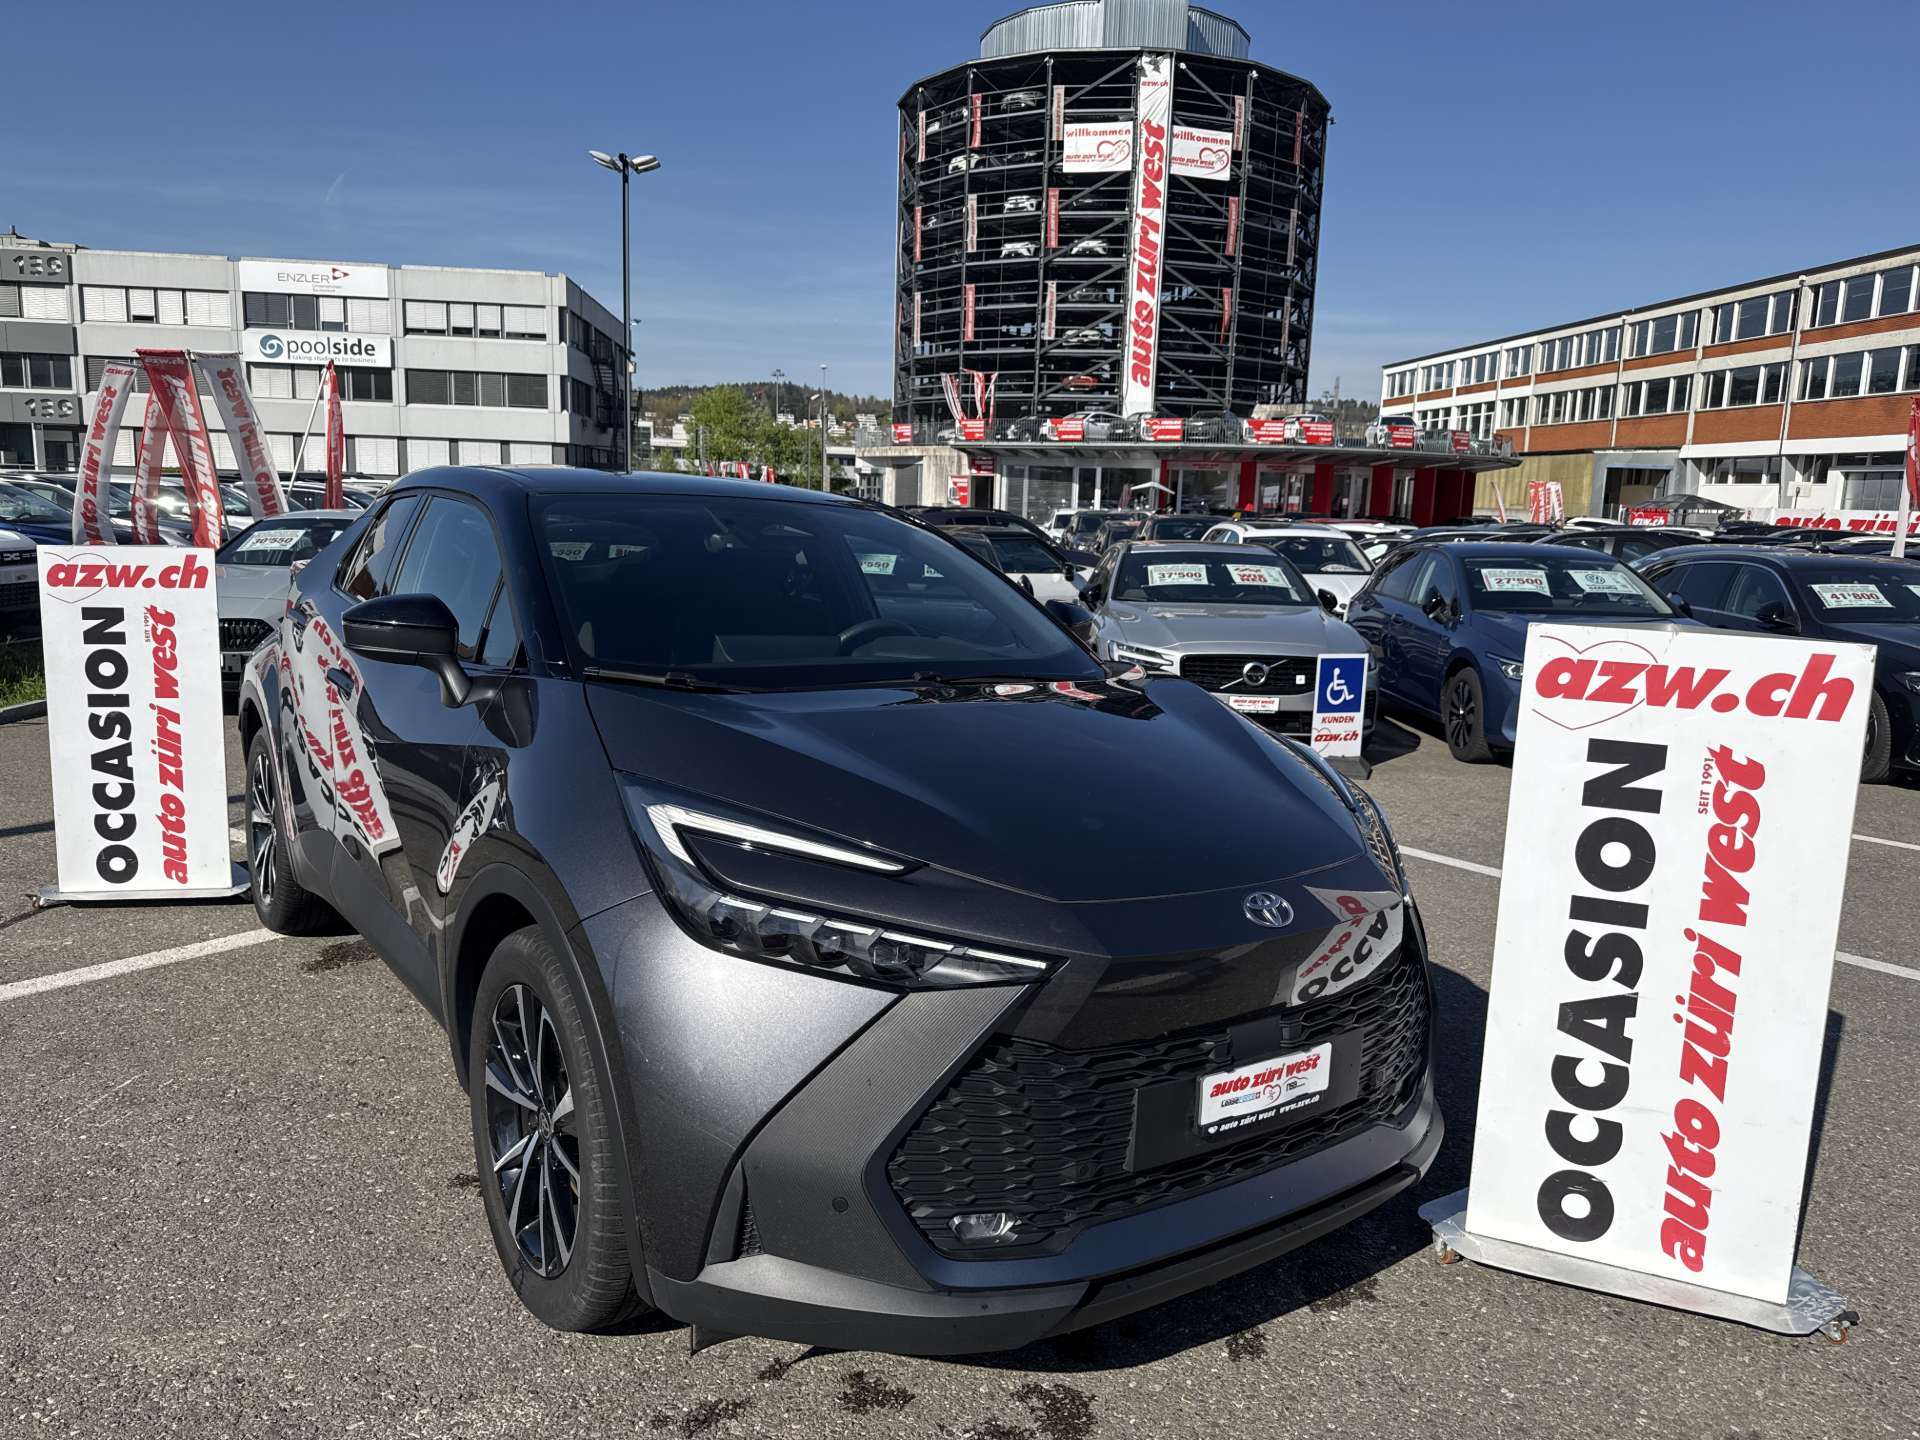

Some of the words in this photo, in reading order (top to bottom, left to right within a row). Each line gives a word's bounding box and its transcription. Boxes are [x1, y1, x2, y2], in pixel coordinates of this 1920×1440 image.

[1066, 127, 1131, 138] willkommen
[1172, 130, 1231, 145] willkommen
[1142, 119, 1165, 210] west
[13, 254, 63, 276] 139
[1133, 212, 1161, 299] züri
[277, 272, 330, 284] ENZLER
[287, 337, 376, 359] poolside
[1131, 300, 1155, 388] auto
[25, 399, 73, 419] 139
[91, 385, 118, 441] west
[46, 554, 208, 589] azw.ch
[1495, 576, 1543, 586] 27'500
[1830, 592, 1880, 600] 41'800
[149, 604, 179, 699] west
[1534, 653, 1855, 723] azw.ch
[1314, 730, 1360, 742] azw.ch
[1321, 715, 1356, 724] KUNDEN
[81, 606, 139, 884] OCCASION
[149, 702, 185, 793] züri
[1701, 755, 1714, 780] 1991
[1697, 780, 1710, 816] SEIT
[155, 793, 189, 885] auto
[1698, 743, 1767, 927] west
[1536, 737, 1669, 1243] OCCASION
[1671, 927, 1743, 1104] züri
[1209, 1076, 1251, 1098] auto
[1250, 1062, 1286, 1089] züri
[1285, 1054, 1321, 1078] west
[1219, 1120, 1240, 1132] auto
[1239, 1113, 1258, 1127] züri
[1258, 1109, 1277, 1120] west
[1660, 1097, 1723, 1274] auto
